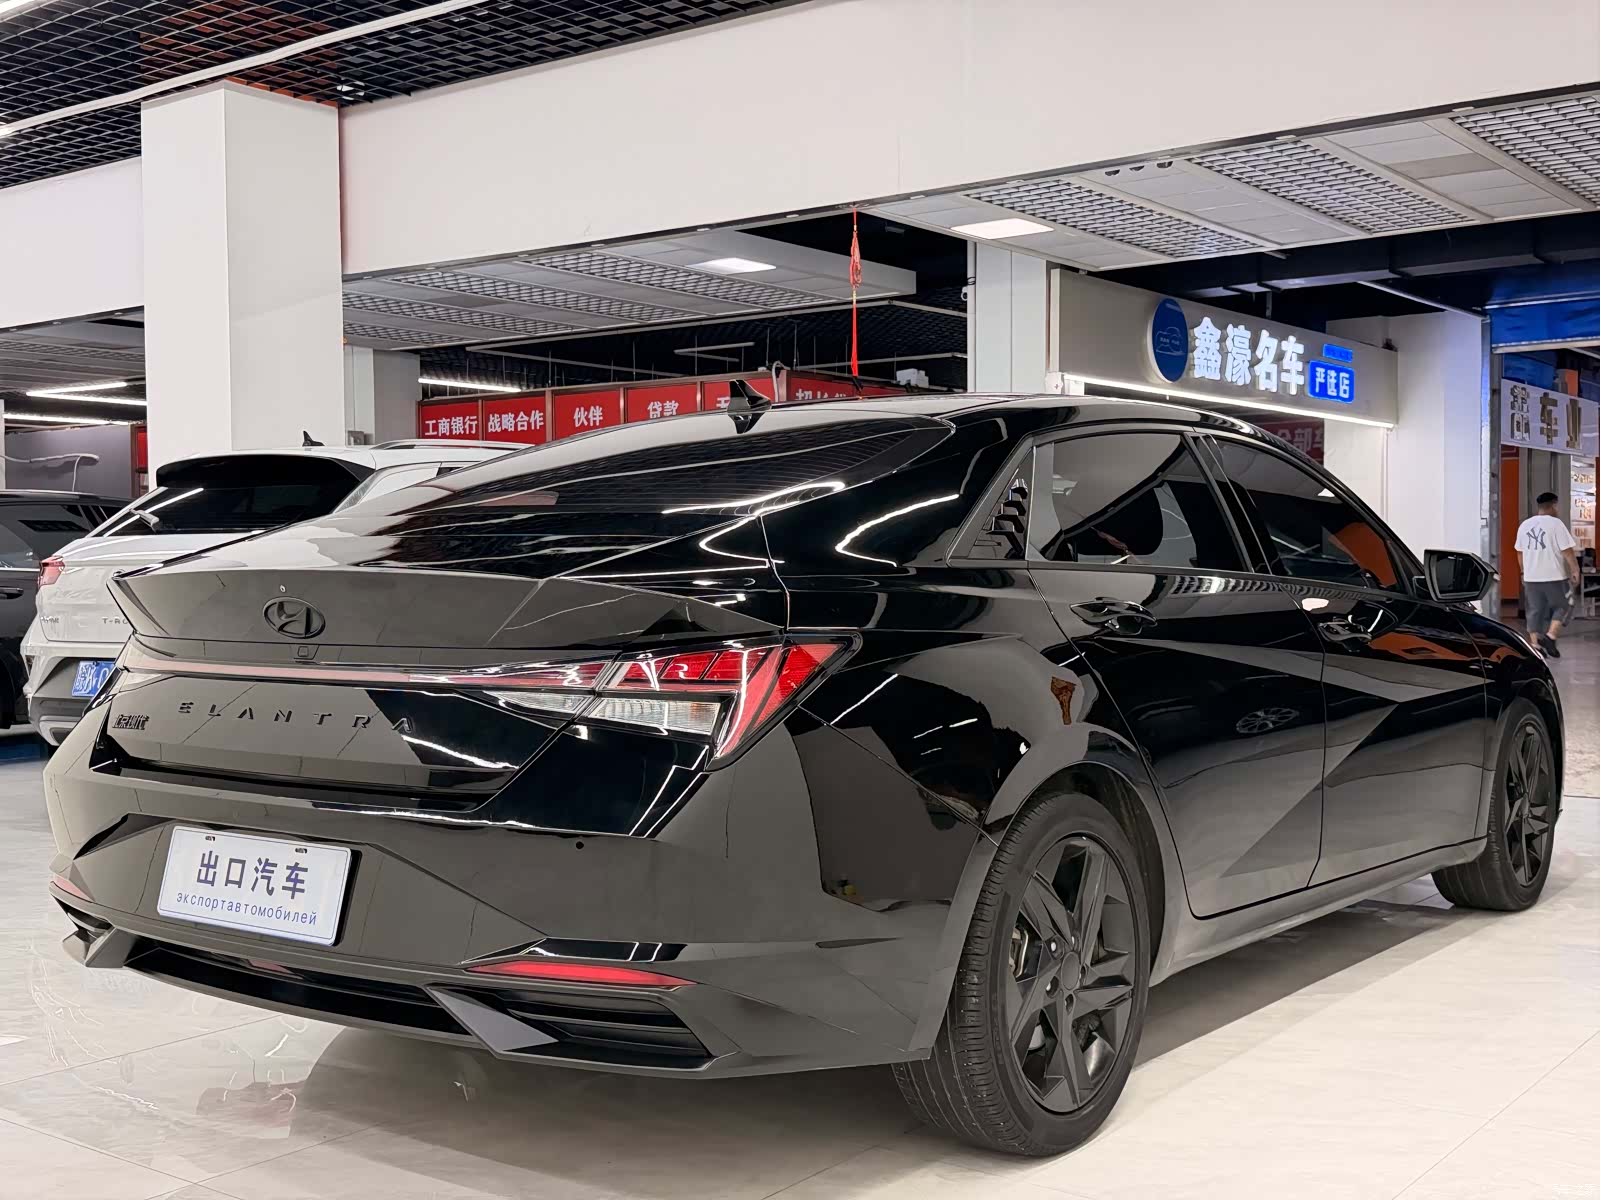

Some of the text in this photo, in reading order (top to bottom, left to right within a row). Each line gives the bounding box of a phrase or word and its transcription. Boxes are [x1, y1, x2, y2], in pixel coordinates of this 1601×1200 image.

[1193, 316, 1305, 396] 鑫濠名车
[1315, 366, 1350, 399] 严选店
[424, 400, 680, 437] 工商银行 战略合作 伙伴 贷款
[178, 701, 417, 732] ELANTRA
[196, 850, 309, 900] 出口汽车
[176, 892, 318, 926] экспортавтомобилей
